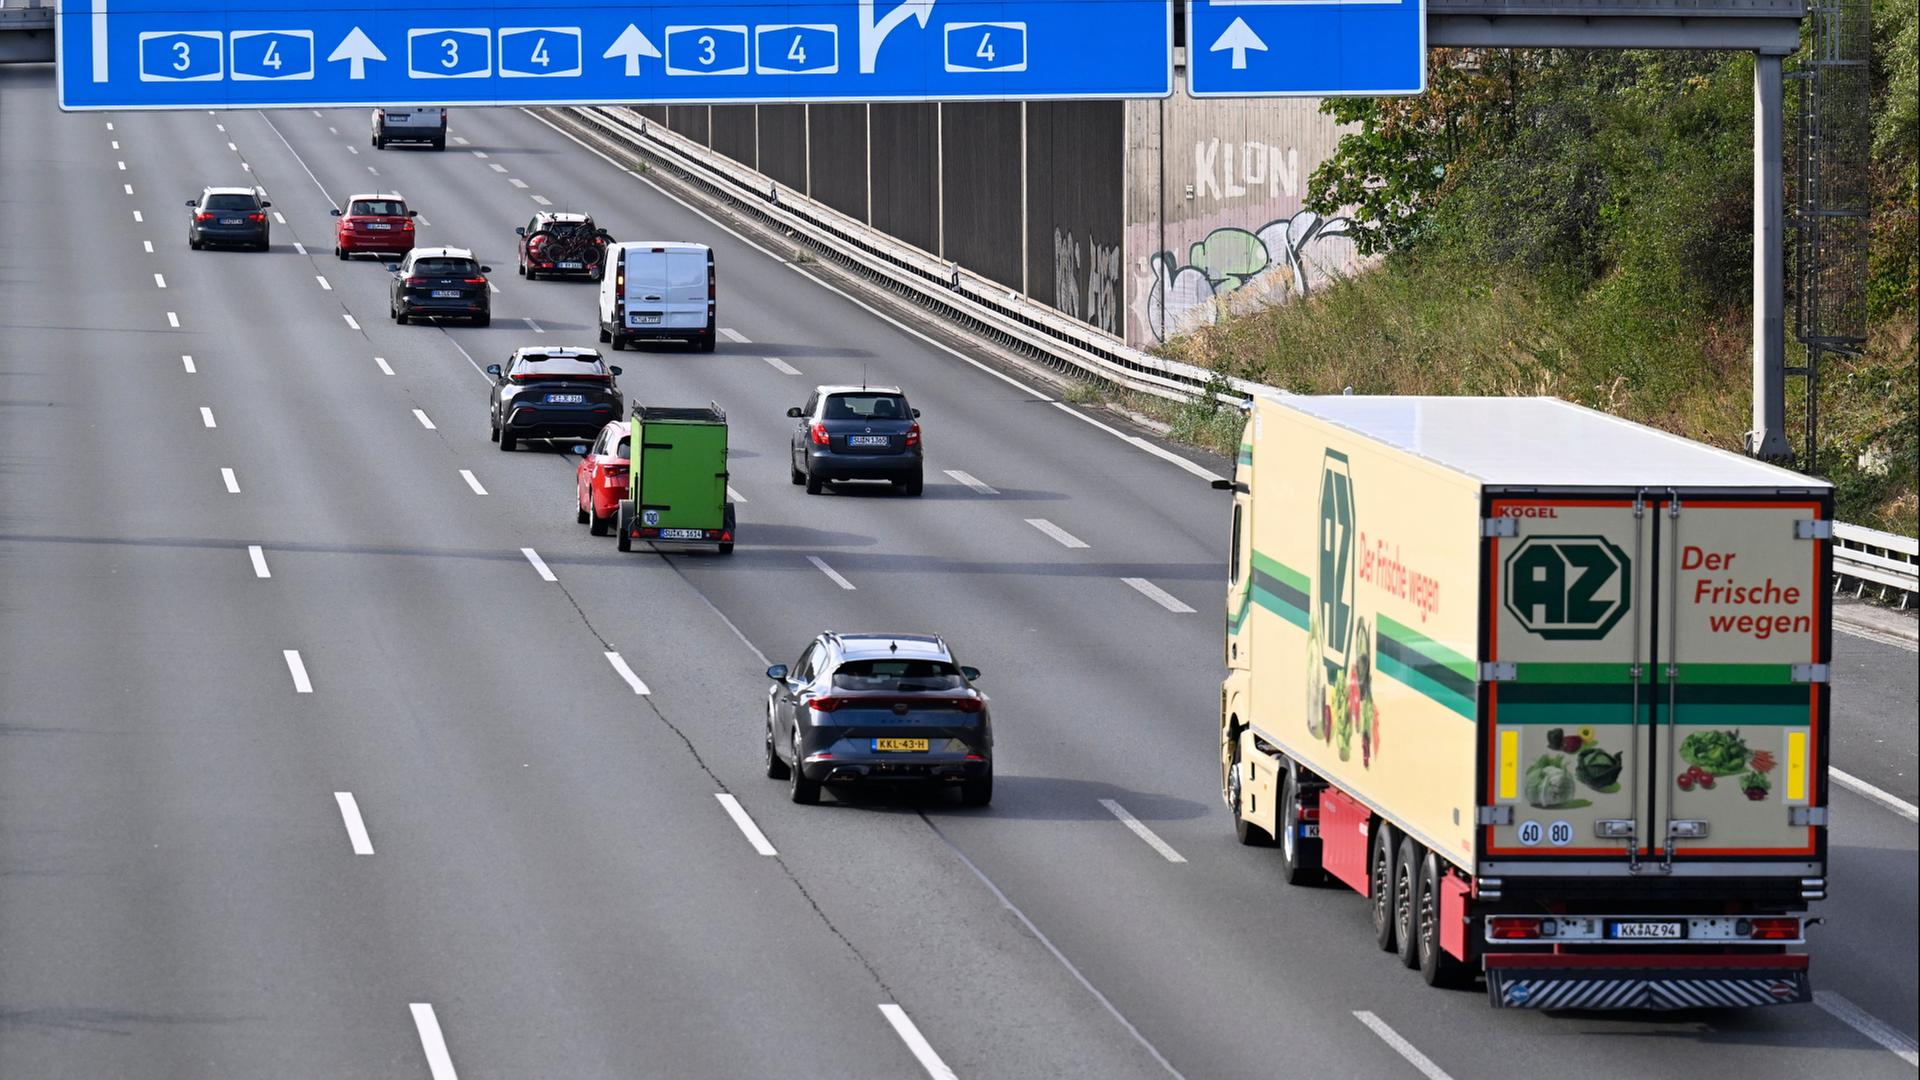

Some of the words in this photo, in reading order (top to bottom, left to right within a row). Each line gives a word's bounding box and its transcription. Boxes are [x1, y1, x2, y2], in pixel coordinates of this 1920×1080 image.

[172, 42, 191, 71] 3
[263, 41, 282, 70] 4
[441, 38, 459, 68] 3
[531, 38, 550, 67] 4
[698, 35, 716, 65] 3
[787, 35, 806, 64] 4
[976, 32, 995, 61] 4
[1319, 467, 1353, 654] AZ
[1681, 545, 1736, 571] Der
[1359, 531, 1375, 583] Der
[1376, 539, 1406, 600] Frische
[1408, 569, 1439, 623] wegen
[1513, 544, 1618, 624] AZ
[1694, 578, 1800, 605] Frische
[1710, 614, 1810, 640] wegen
[1522, 824, 1539, 842] 60
[1552, 824, 1569, 842] 80
